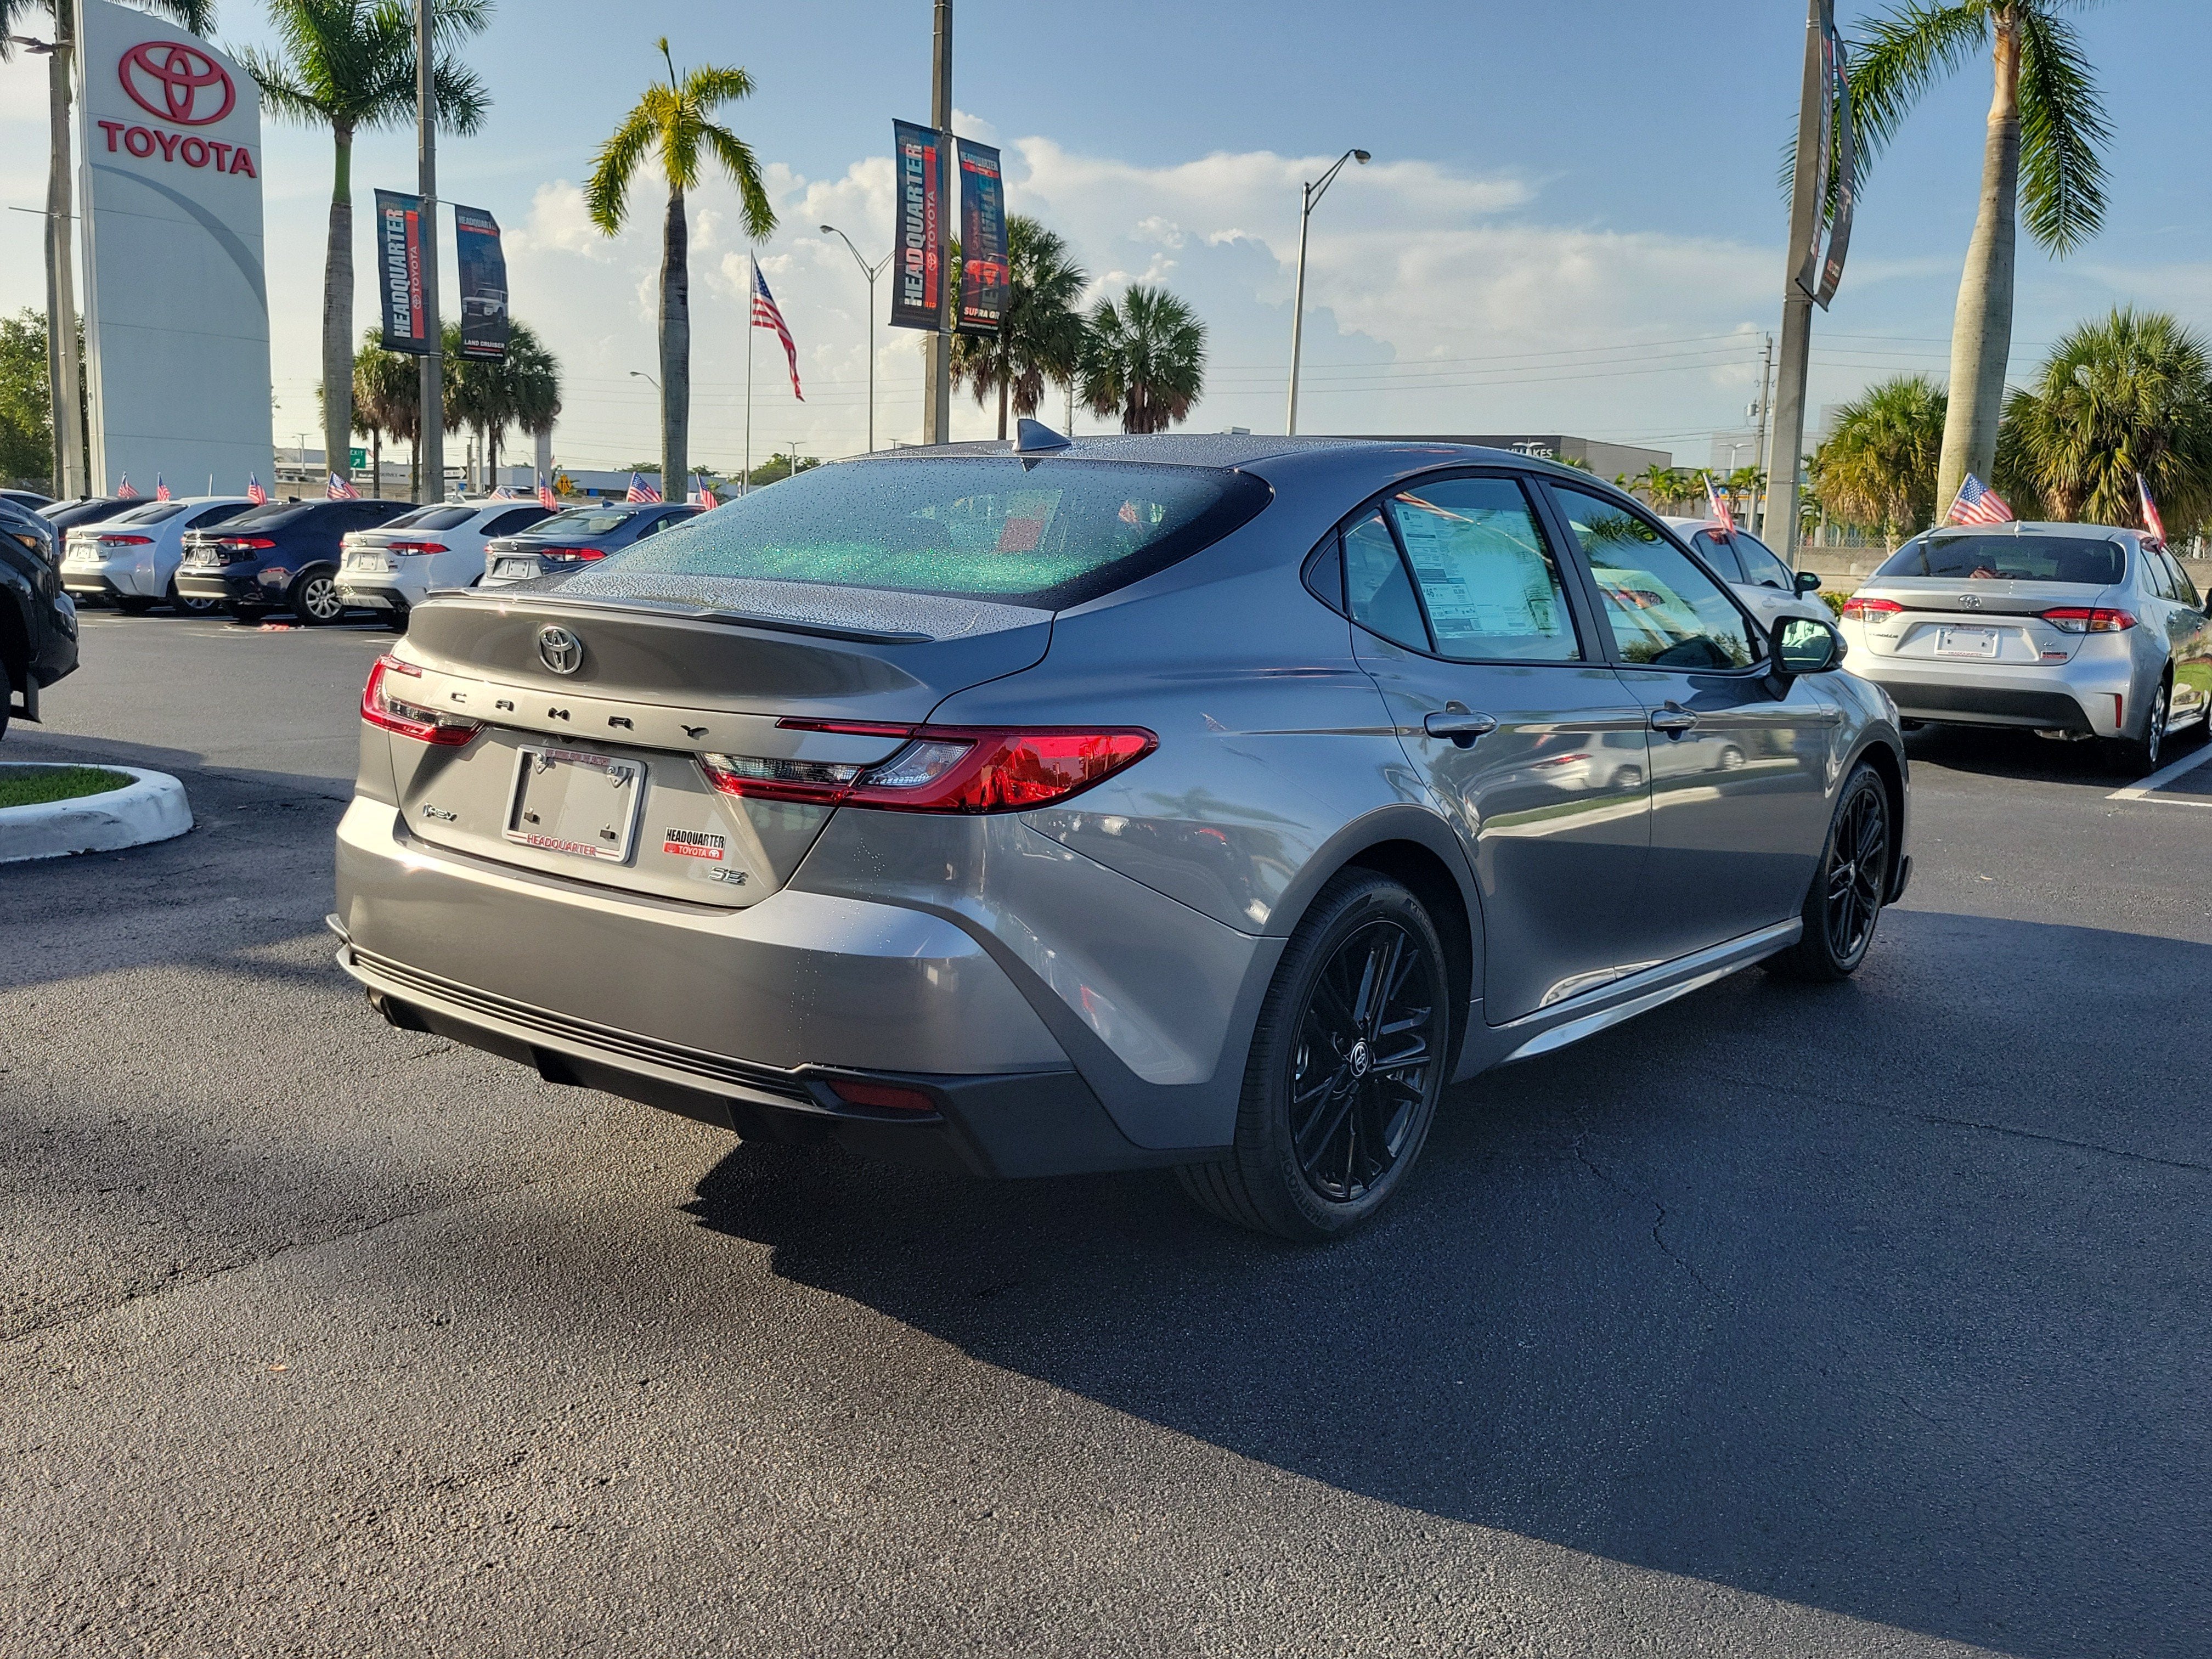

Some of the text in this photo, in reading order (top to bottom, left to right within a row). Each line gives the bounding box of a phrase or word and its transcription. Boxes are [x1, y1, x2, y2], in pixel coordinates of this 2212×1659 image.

[98, 120, 257, 178] TOYOTA
[905, 143, 926, 306] HEADQUARTER
[926, 190, 936, 251] TOYOTA
[385, 208, 411, 338] HEADQUARTER
[410, 246, 420, 292] TOYOTA
[963, 306, 989, 318] SUPRA
[480, 341, 505, 349] CRUISER
[450, 691, 709, 741] CAMRY
[527, 833, 597, 857] HEADQUARTER
[665, 827, 725, 849] HEADQUARTER
[678, 845, 708, 857] TOYOTA
[707, 866, 748, 885] SE
